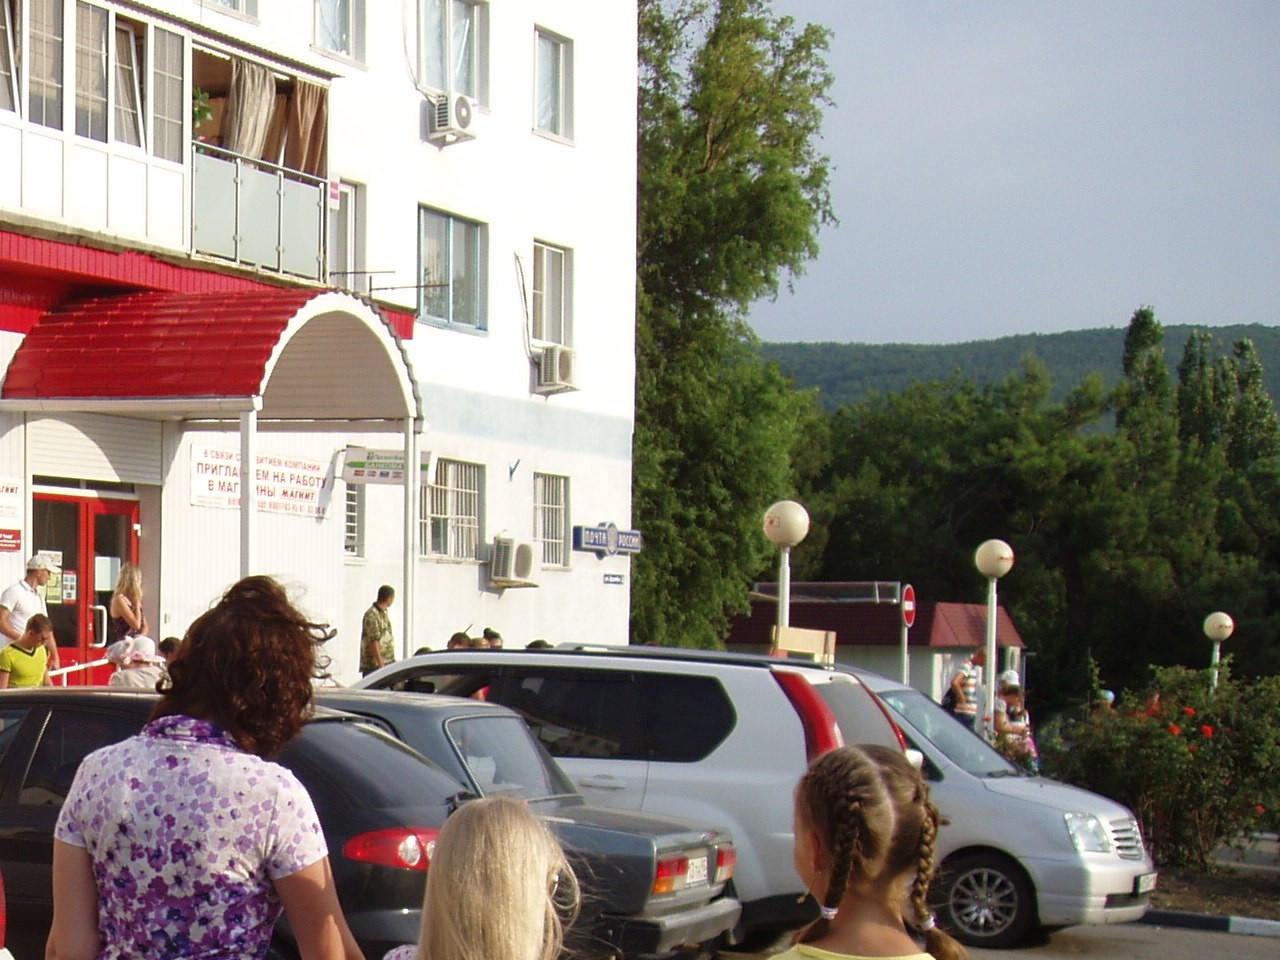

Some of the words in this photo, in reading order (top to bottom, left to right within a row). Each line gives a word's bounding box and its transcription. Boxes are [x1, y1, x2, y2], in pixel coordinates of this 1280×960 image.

[210, 450, 233, 461] СВЯЗИ
[284, 460, 321, 472] КОМПАНИИ
[208, 479, 214, 491] В
[281, 488, 314, 500] МАГНИТ
[273, 471, 286, 483] НА
[289, 473, 327, 489] РАБОТУ
